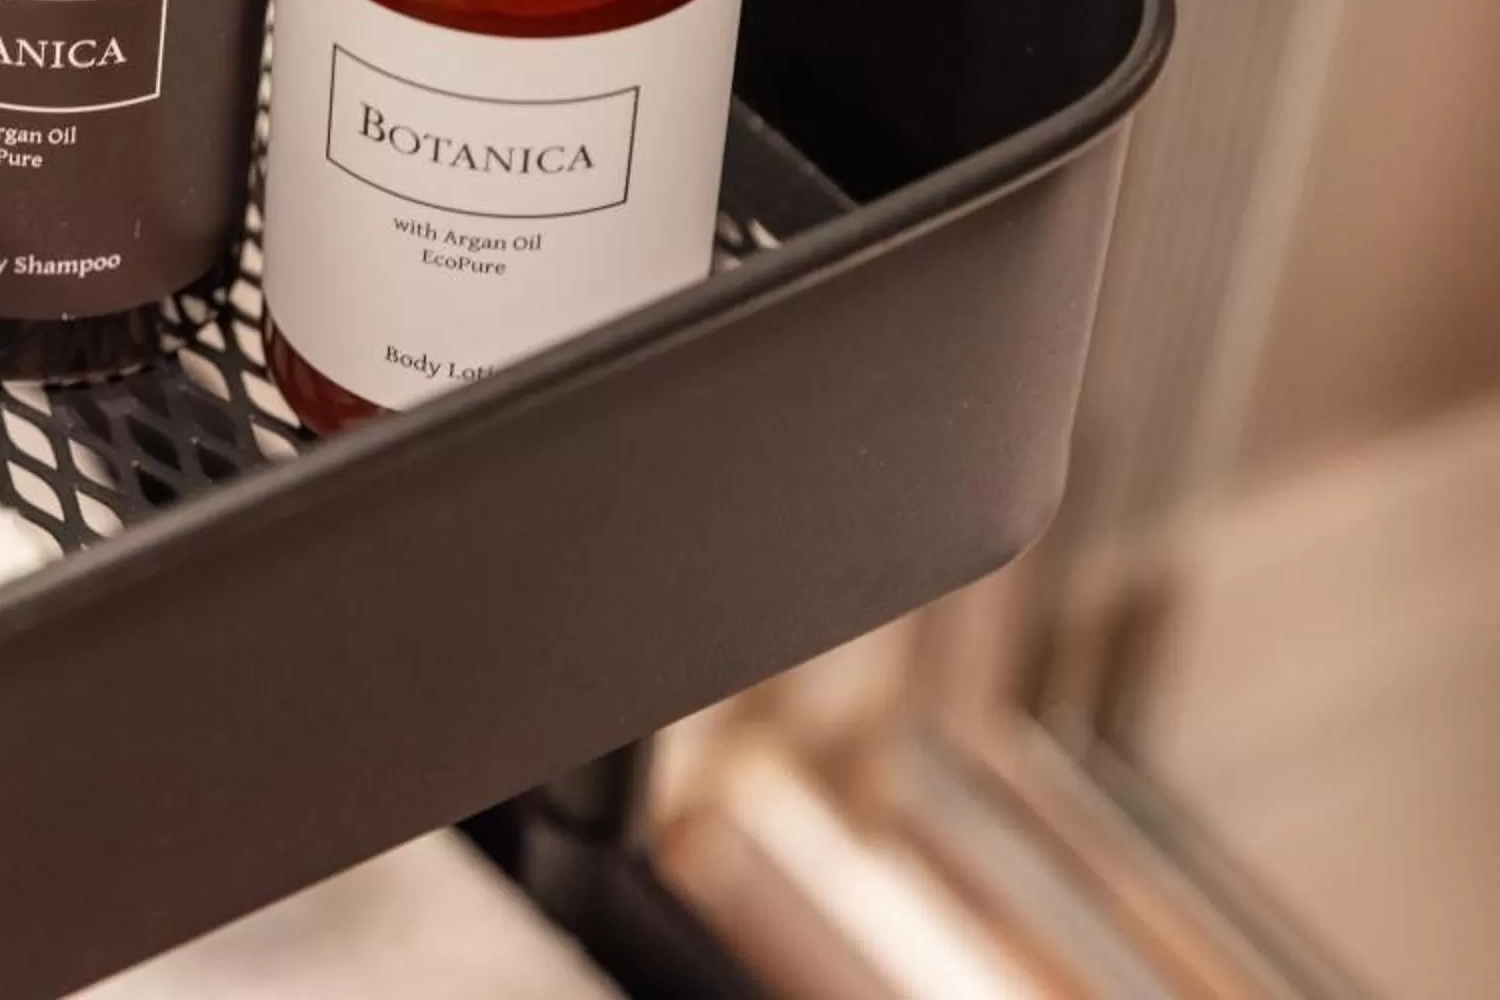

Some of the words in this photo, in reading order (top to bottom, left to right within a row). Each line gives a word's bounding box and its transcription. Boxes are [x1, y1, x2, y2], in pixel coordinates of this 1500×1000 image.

[48, 127, 77, 145] Oil
[358, 102, 596, 175] BOTANICA
[393, 216, 438, 243] with
[443, 230, 507, 252] Argan
[513, 234, 543, 251] Oil
[13, 253, 122, 279] Shampoo
[421, 249, 507, 276] EcoPure
[385, 345, 442, 380] Body
